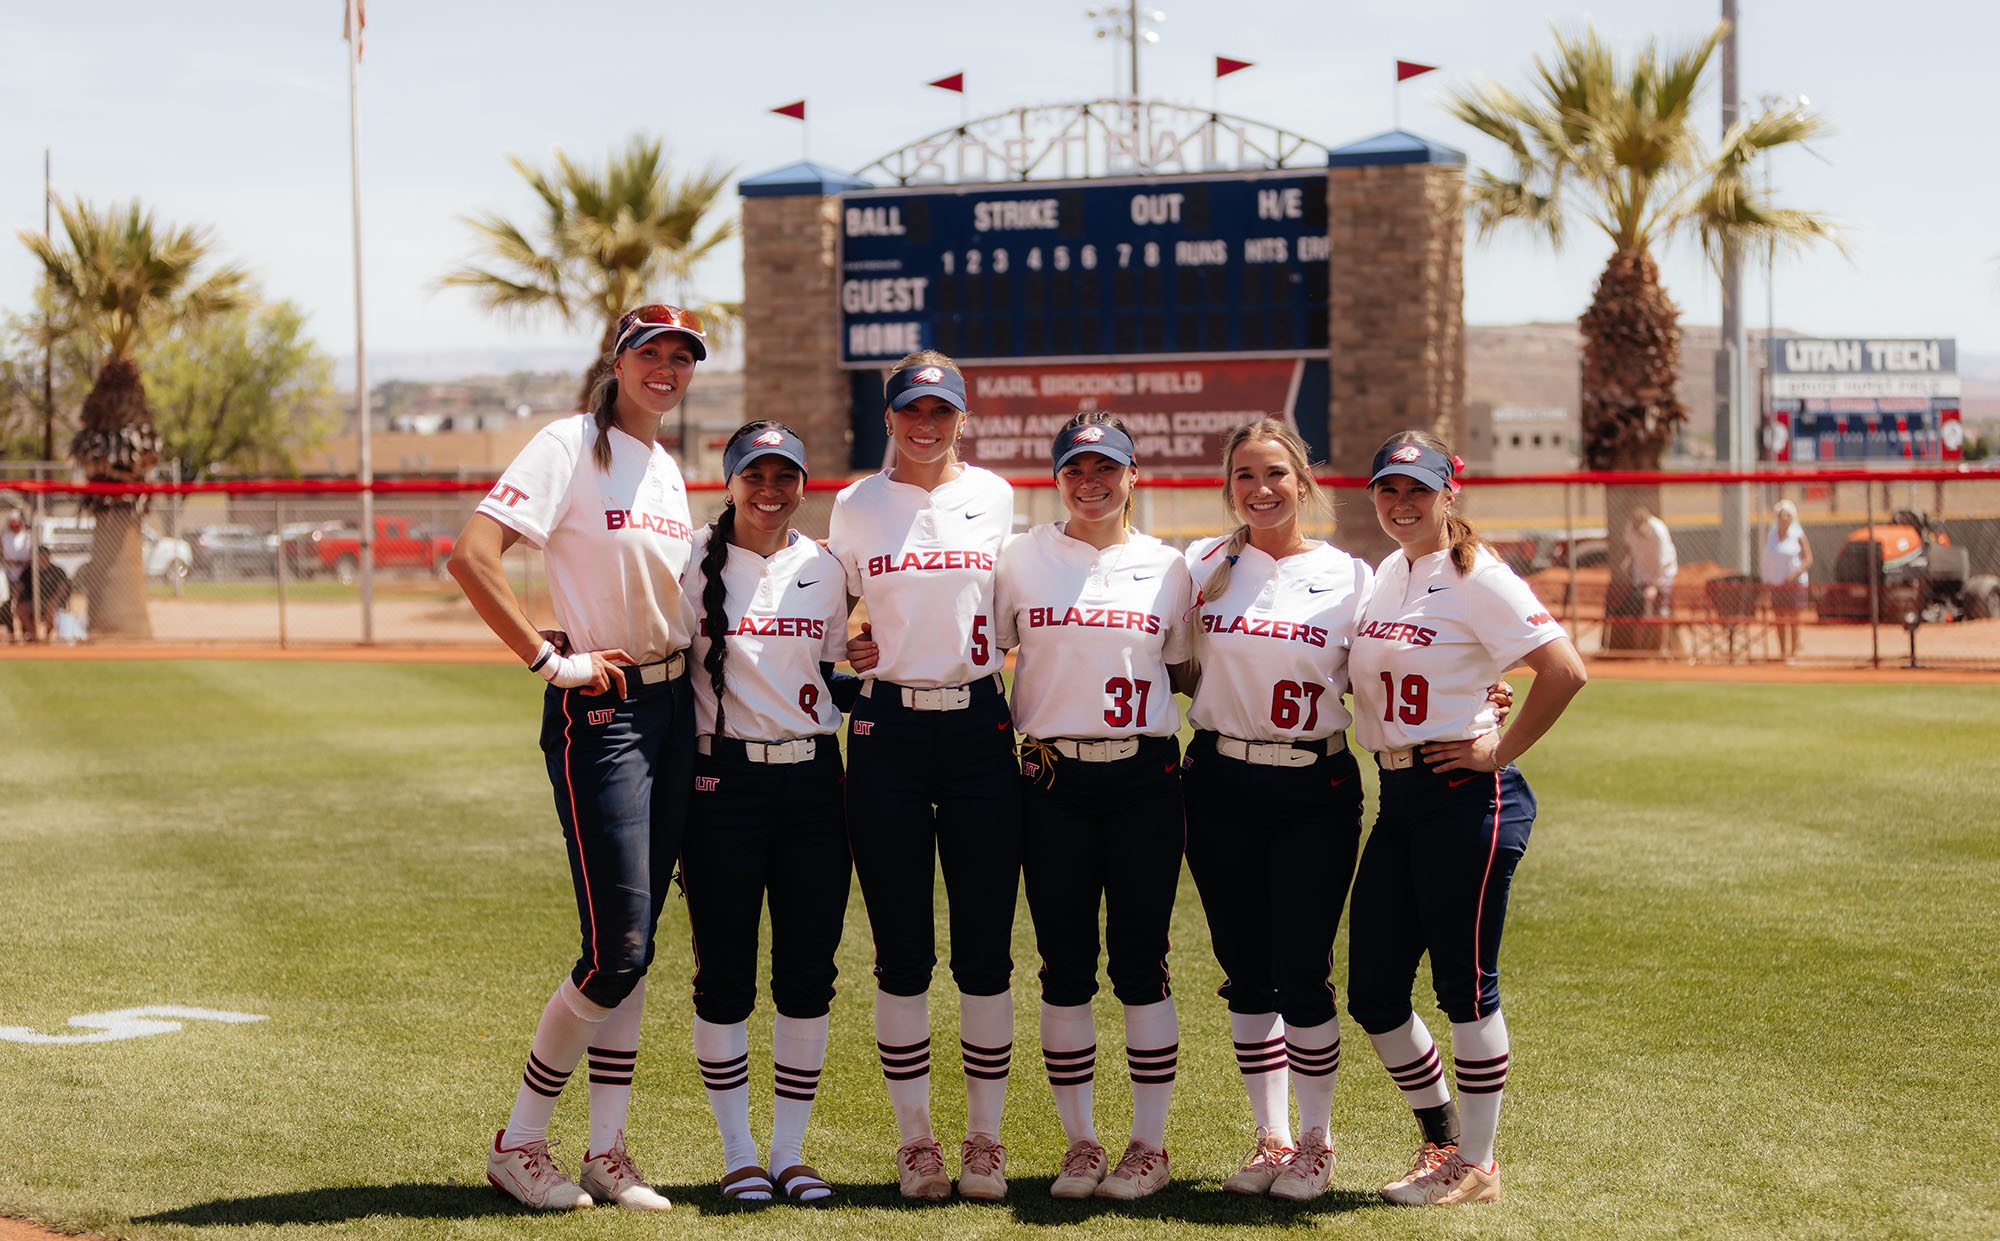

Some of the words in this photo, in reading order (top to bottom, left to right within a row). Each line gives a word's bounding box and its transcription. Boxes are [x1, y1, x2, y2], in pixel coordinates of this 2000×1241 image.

[845, 206, 906, 237] BALL
[974, 199, 1059, 232] STRIKE
[1130, 193, 1184, 225] OUT
[1258, 188, 1303, 221] H/E
[942, 251, 954, 275] 1
[966, 249, 982, 274] 2
[992, 248, 1009, 274] 3
[1026, 246, 1043, 271] 4
[1054, 245, 1070, 271] 5
[1081, 244, 1097, 269] 6
[1116, 242, 1132, 268] 7
[1144, 242, 1160, 268] 8
[1175, 239, 1228, 266] RUNS
[1244, 236, 1288, 264] HITS
[842, 277, 928, 314] GUEST
[849, 322, 921, 356] HOME
[1785, 340, 1861, 372] UTAH
[1865, 340, 1941, 371] TECH
[976, 375, 1037, 398] KARL
[1040, 373, 1133, 396] BROOKS
[1137, 371, 1203, 394] FIELD
[868, 551, 994, 577] BLAZERS
[1029, 607, 1160, 635] BLAZERS
[971, 615, 990, 666] 5
[1104, 676, 1152, 728] 37
[1271, 679, 1325, 731] 67
[1380, 671, 1429, 725] 19
[695, 776, 720, 791] UT
